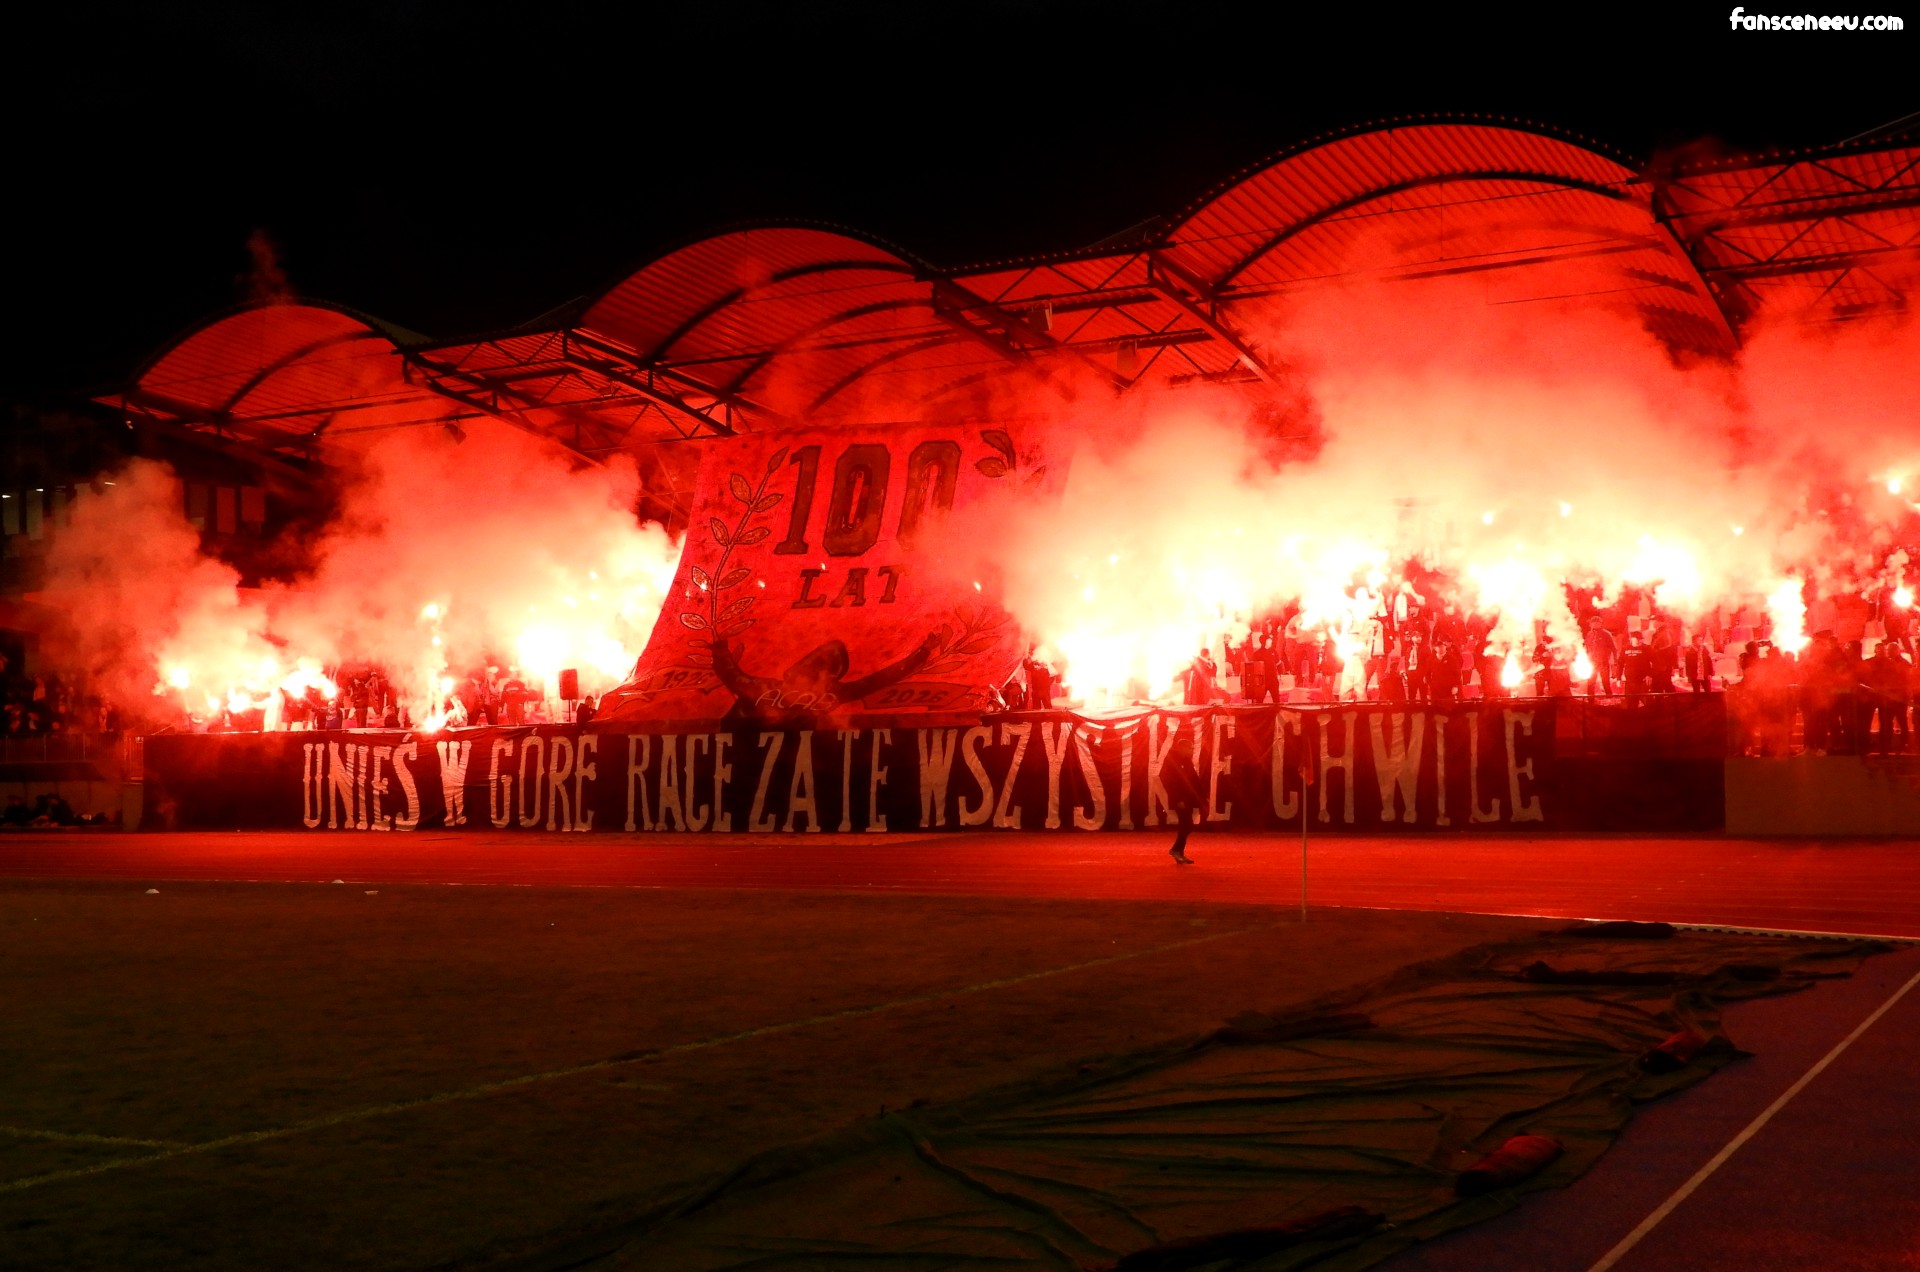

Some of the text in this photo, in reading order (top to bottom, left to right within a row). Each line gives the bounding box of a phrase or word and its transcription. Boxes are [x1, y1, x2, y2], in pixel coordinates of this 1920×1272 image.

[774, 440, 962, 557] 100
[791, 565, 905, 609] LAT
[755, 688, 837, 711] ACAB
[877, 689, 949, 703] 2026
[303, 733, 420, 832] UNIEŚ
[436, 740, 472, 827] W
[489, 727, 598, 832] GÓRE
[624, 733, 735, 832] RACE
[748, 730, 821, 832] ZA
[837, 728, 892, 832] TE
[1272, 709, 1544, 826] CHWILE
